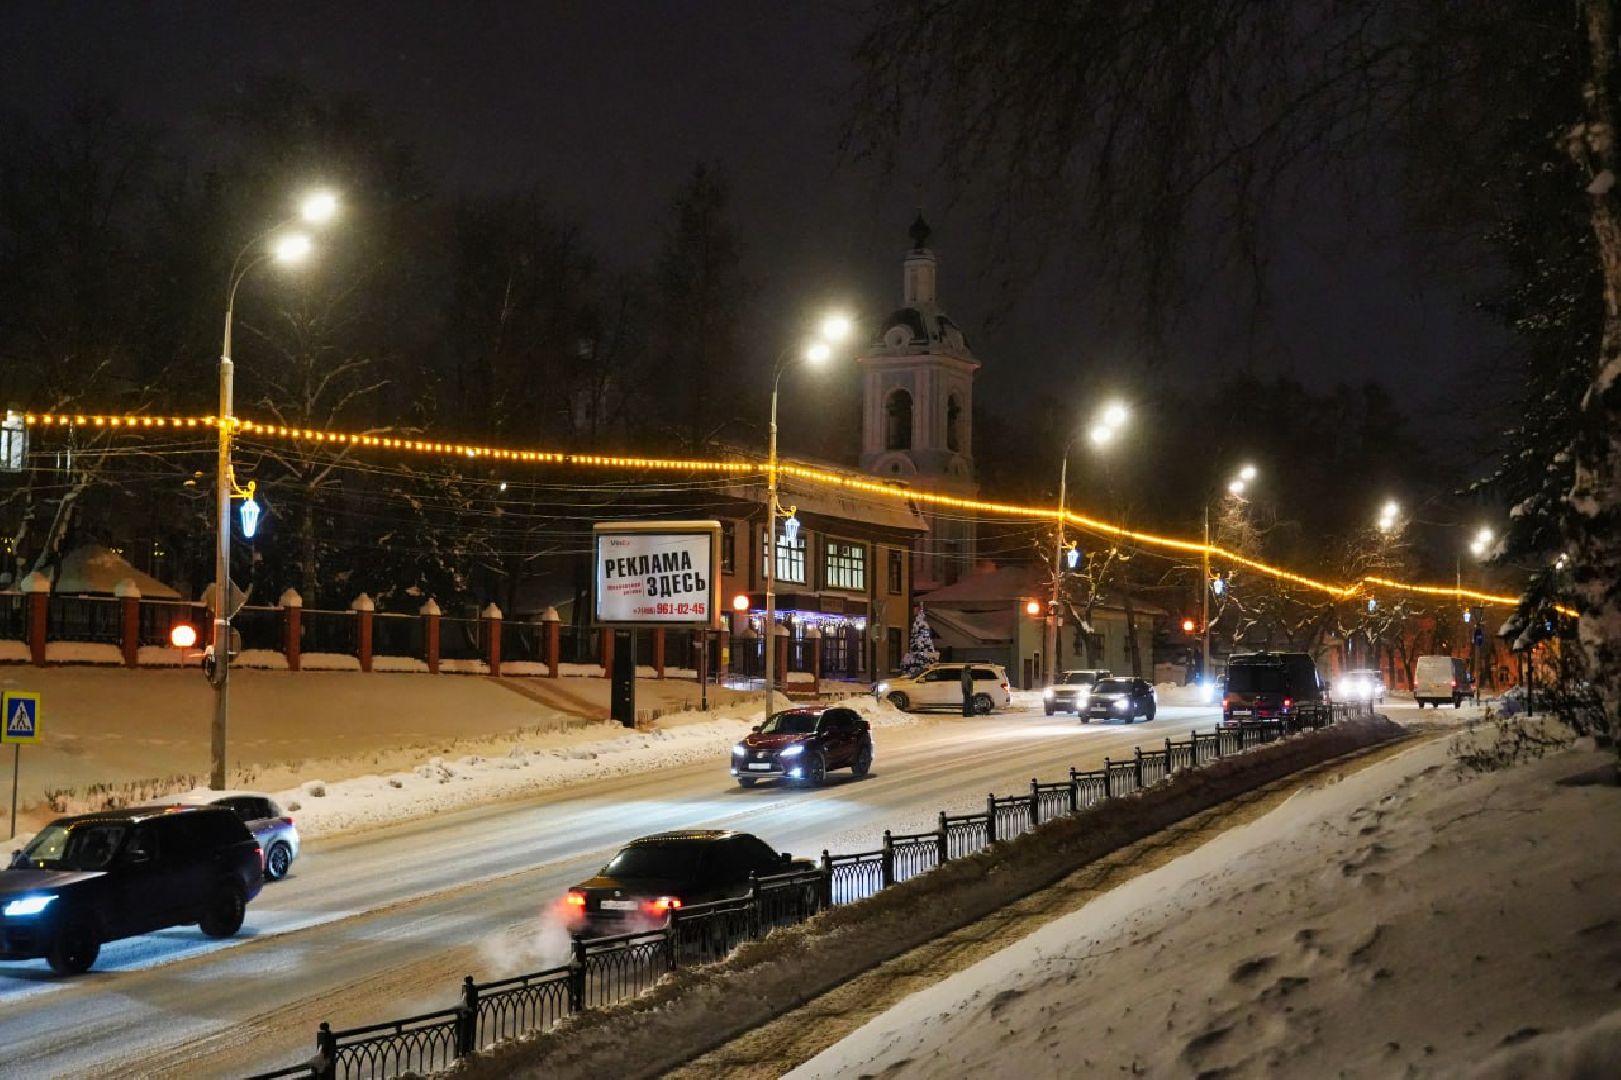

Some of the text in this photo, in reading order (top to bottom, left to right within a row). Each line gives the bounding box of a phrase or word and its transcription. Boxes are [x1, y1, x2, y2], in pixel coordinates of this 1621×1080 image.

[605, 550, 692, 579] РЕКЛАМА
[646, 572, 706, 598] ЗДЕСЬ
[656, 602, 705, 615] 961-02-45
